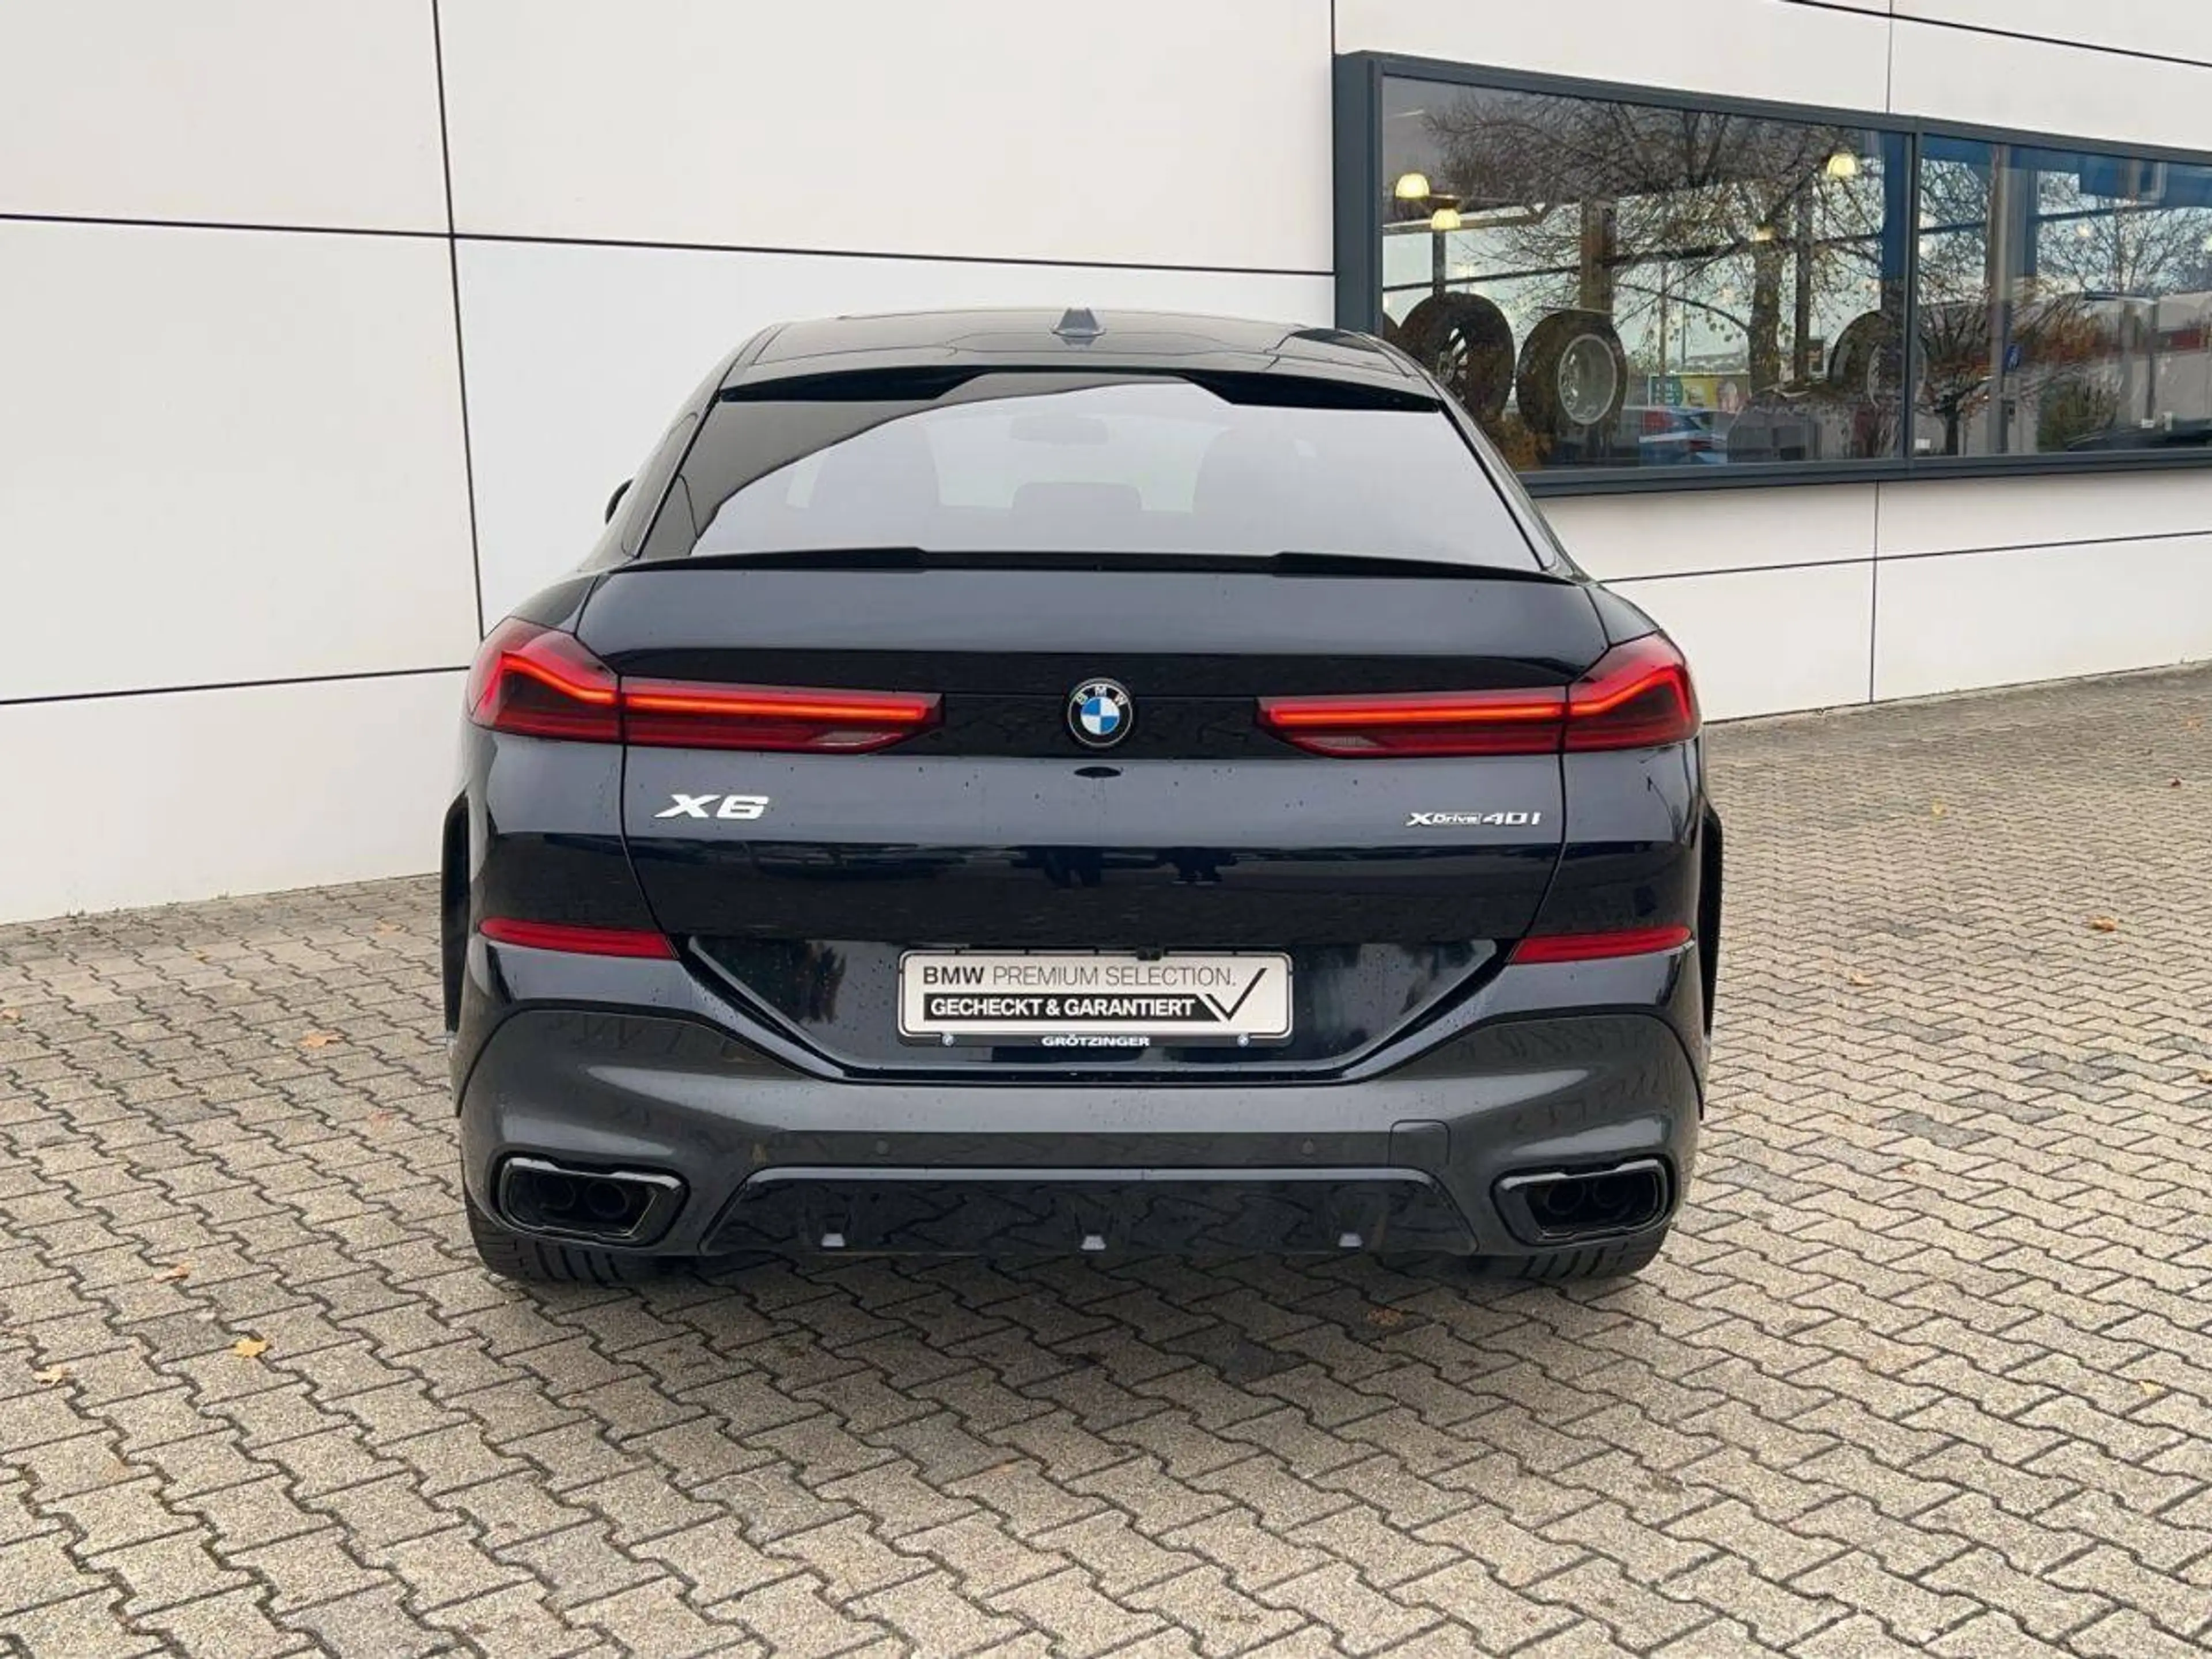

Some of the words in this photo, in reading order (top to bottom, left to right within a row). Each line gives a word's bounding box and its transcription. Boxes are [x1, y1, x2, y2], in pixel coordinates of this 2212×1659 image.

[654, 794, 770, 819] X6
[923, 966, 984, 984] BMW
[993, 966, 1097, 986] PREMIUM
[1105, 966, 1236, 986] SELECTION.
[930, 998, 1044, 1016] GECHECKT
[1046, 998, 1060, 1016] &
[1064, 998, 1195, 1016] GARANTIERT
[1041, 1035, 1150, 1047] GRÖTZINGER
